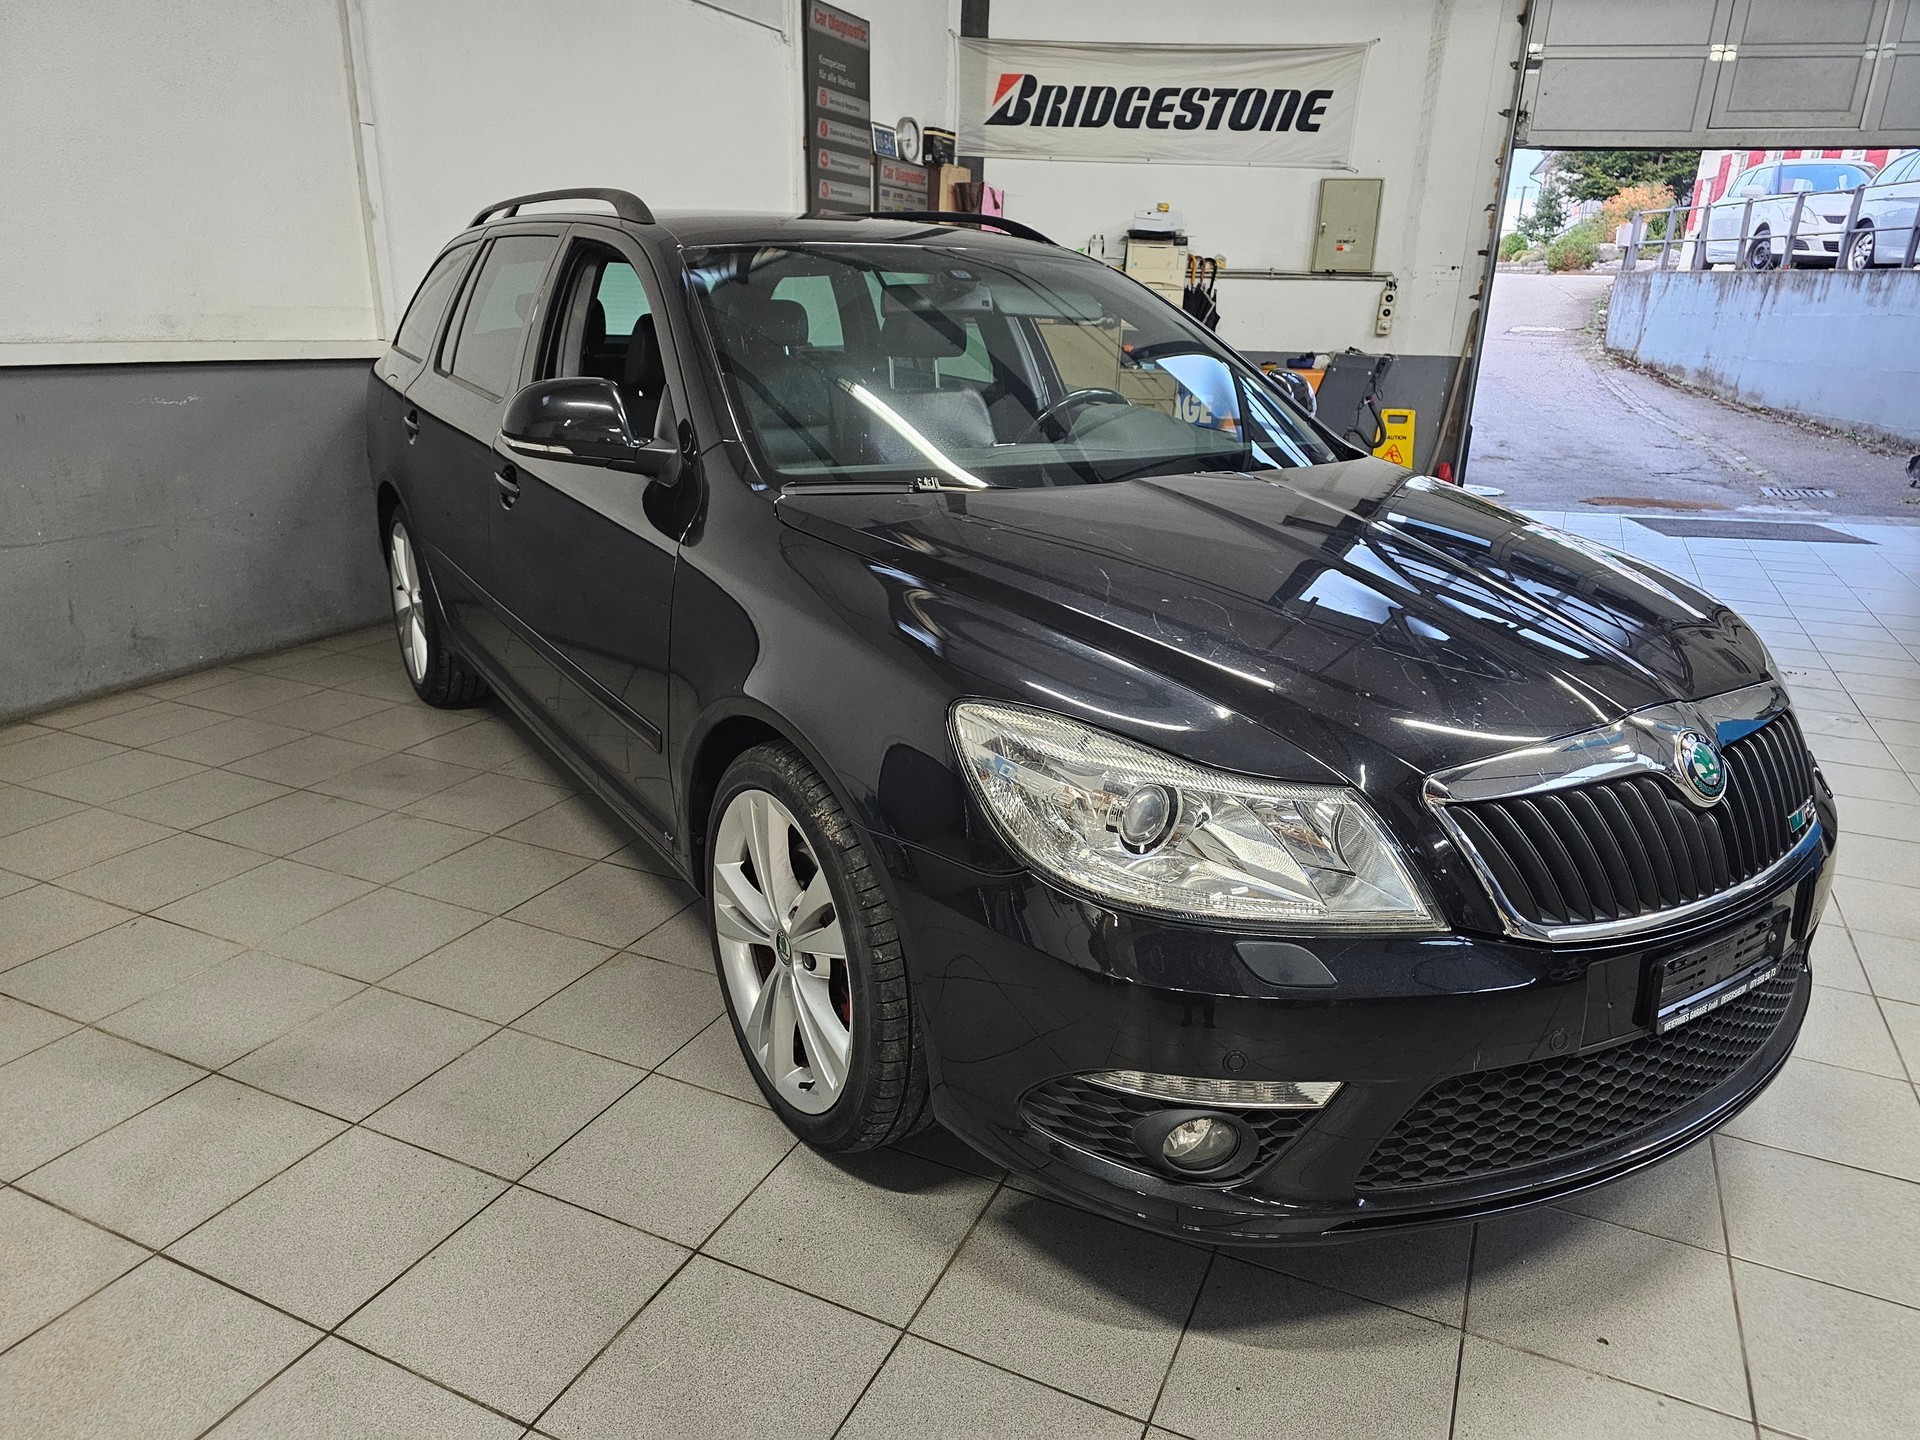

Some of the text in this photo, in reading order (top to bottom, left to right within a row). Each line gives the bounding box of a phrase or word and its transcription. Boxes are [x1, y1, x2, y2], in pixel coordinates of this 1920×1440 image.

[814, 8, 867, 43] Car Diagnostic
[984, 73, 1334, 133] BRIDGESTONE
[883, 165, 927, 186] Car Diagnostic
[1690, 1004, 1708, 1020] GARAGE
